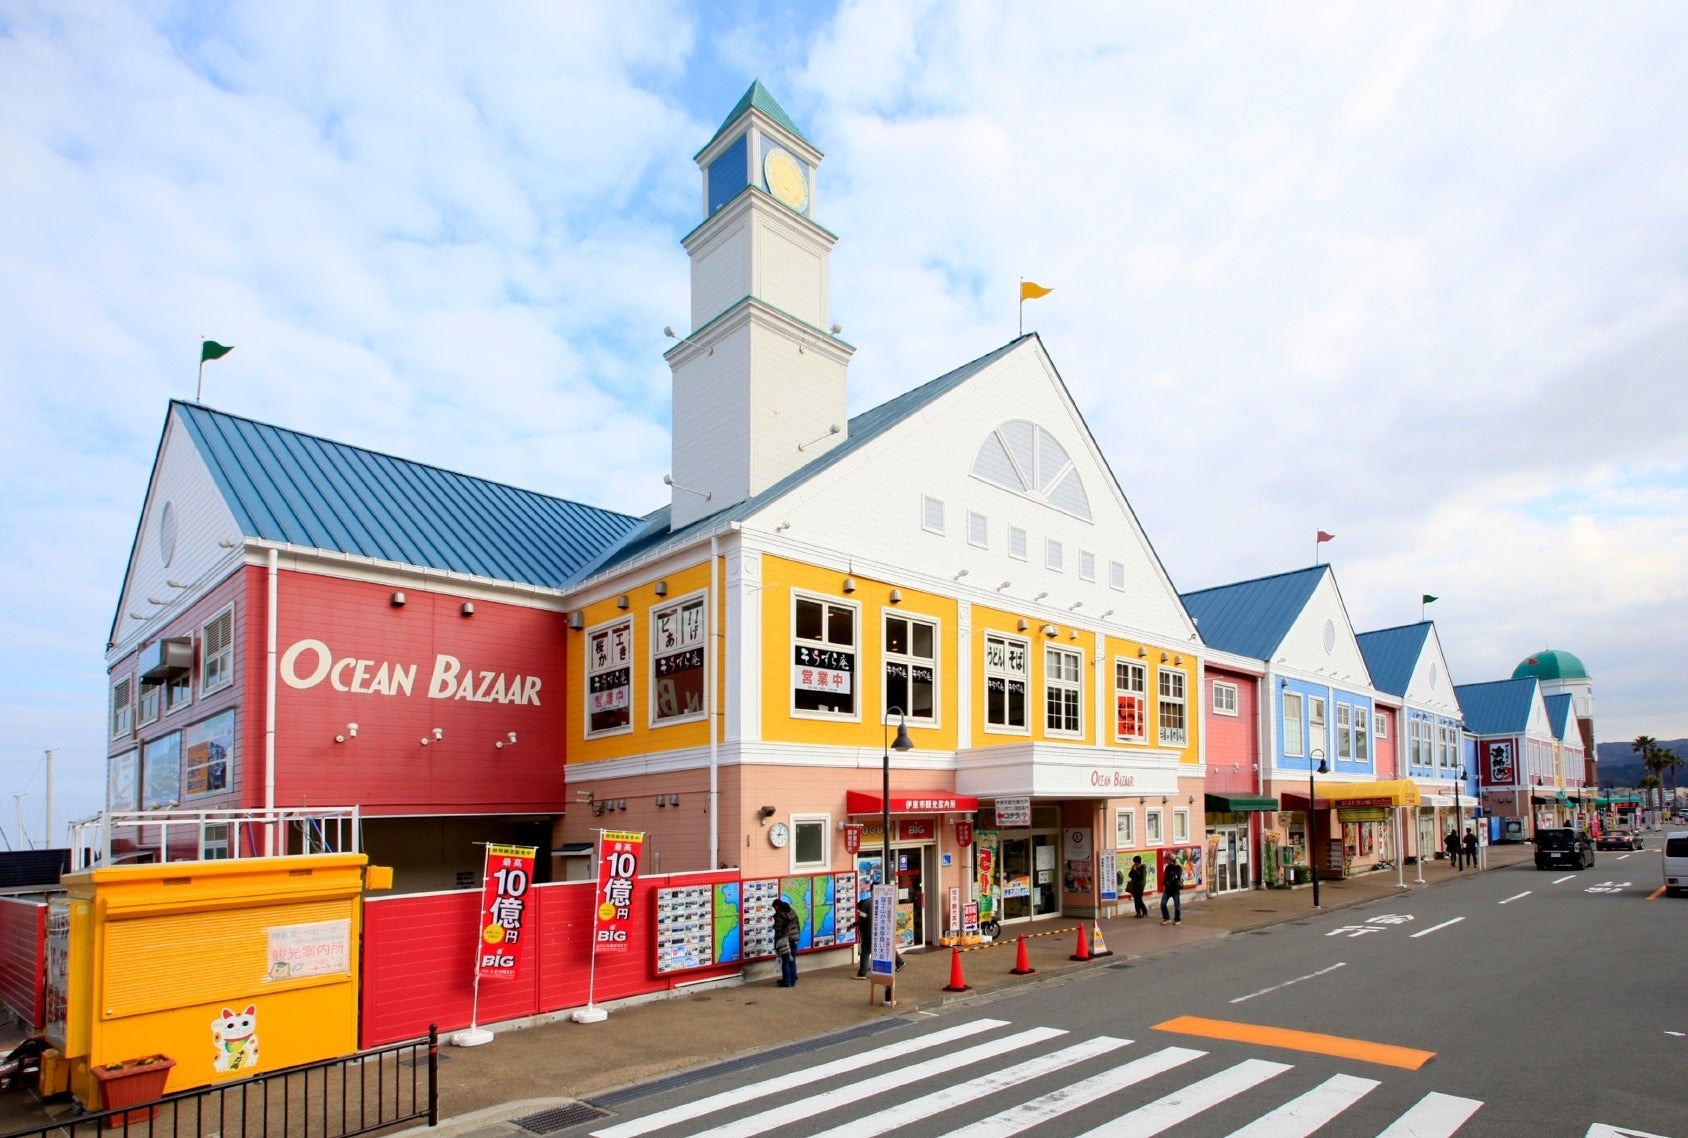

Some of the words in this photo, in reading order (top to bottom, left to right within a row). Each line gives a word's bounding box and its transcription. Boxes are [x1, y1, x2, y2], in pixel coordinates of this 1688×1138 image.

[987, 646, 1003, 667] うどん
[1009, 651, 1023, 670] そば
[280, 638, 417, 697] OCEAN
[428, 653, 542, 706] BAZAAR
[802, 668, 843, 688] 営業中
[595, 691, 624, 709] 営業中
[1091, 769, 1111, 787] OCEAN
[1114, 771, 1134, 788] BAZAAR
[905, 799, 956, 810] 伊東市観光案内所
[908, 825, 925, 835] BIG
[272, 941, 344, 962] 観光案内所
